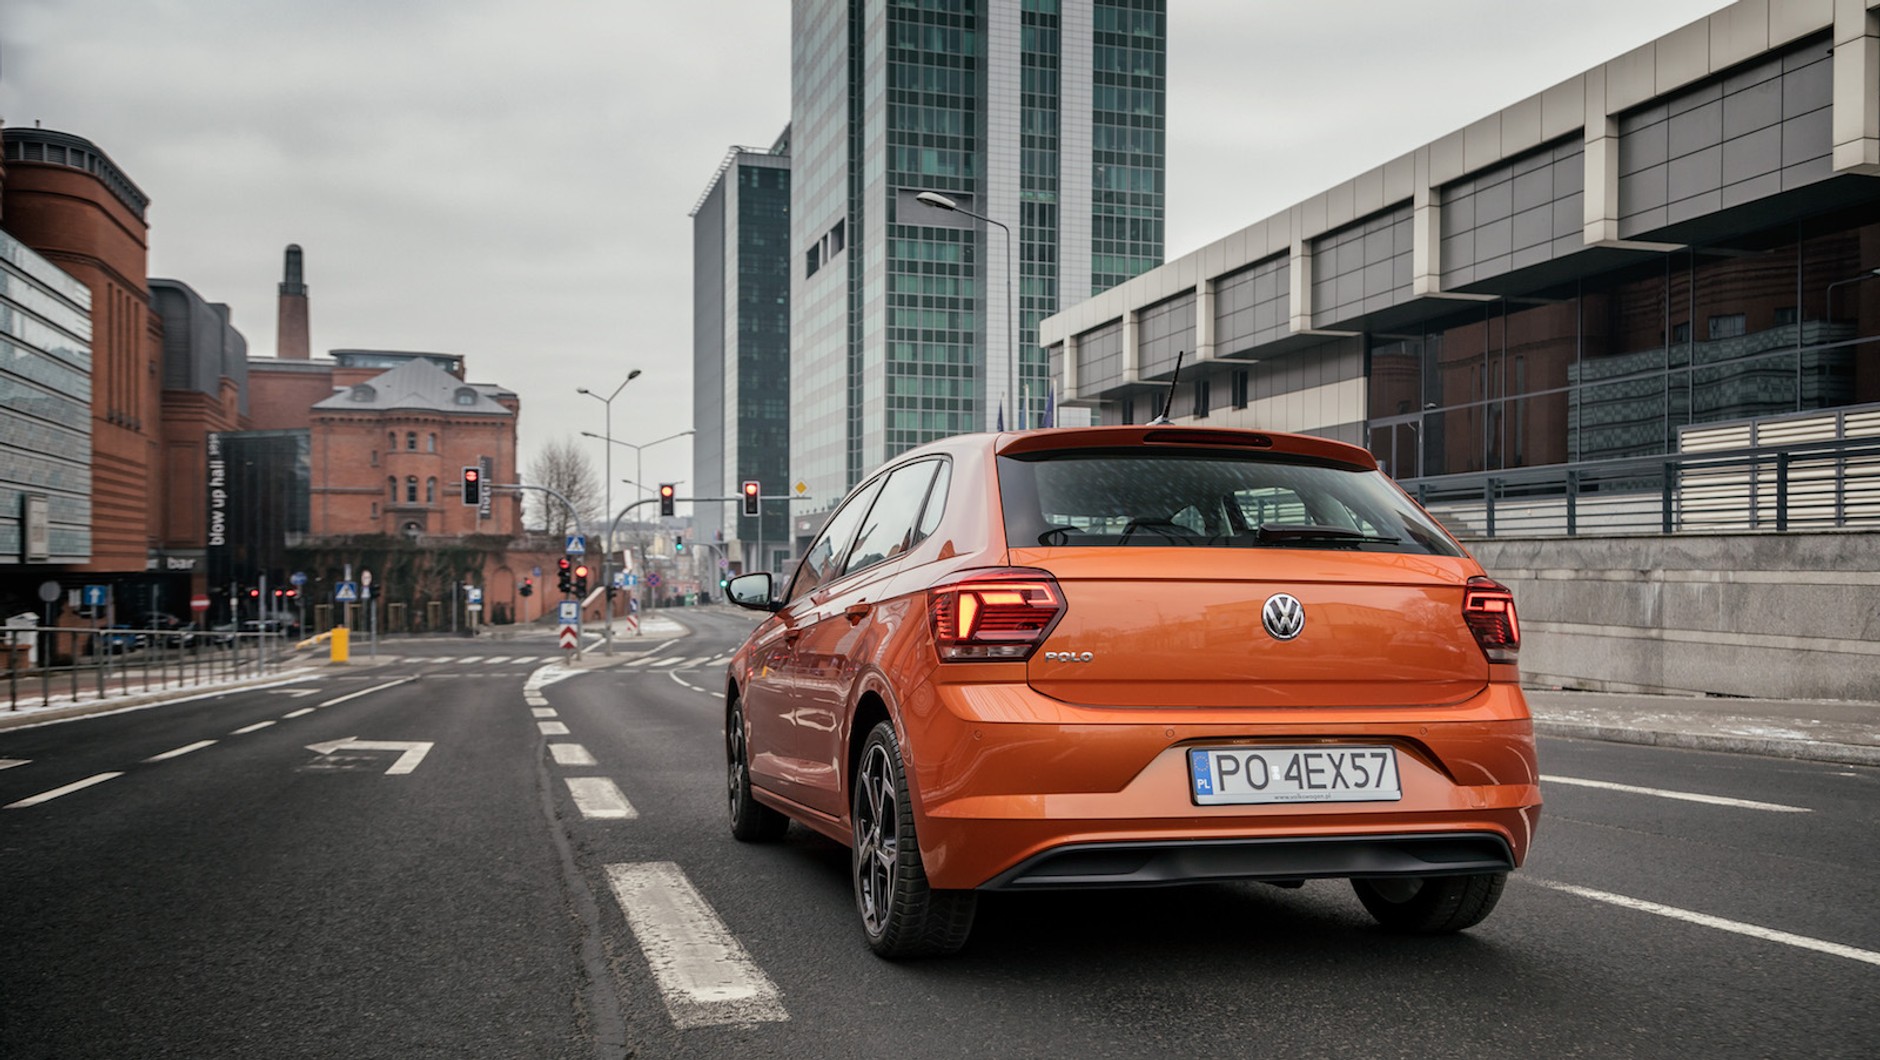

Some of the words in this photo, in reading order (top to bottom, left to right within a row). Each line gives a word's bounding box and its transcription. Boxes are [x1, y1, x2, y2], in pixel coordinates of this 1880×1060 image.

[207, 460, 225, 487] hall
[211, 489, 228, 508] up
[207, 510, 225, 546] blow
[166, 557, 197, 570] bar
[1045, 651, 1094, 662] POLO
[1216, 754, 1269, 791] PO
[1284, 753, 1388, 789] 4EX57
[1197, 779, 1210, 789] PL
